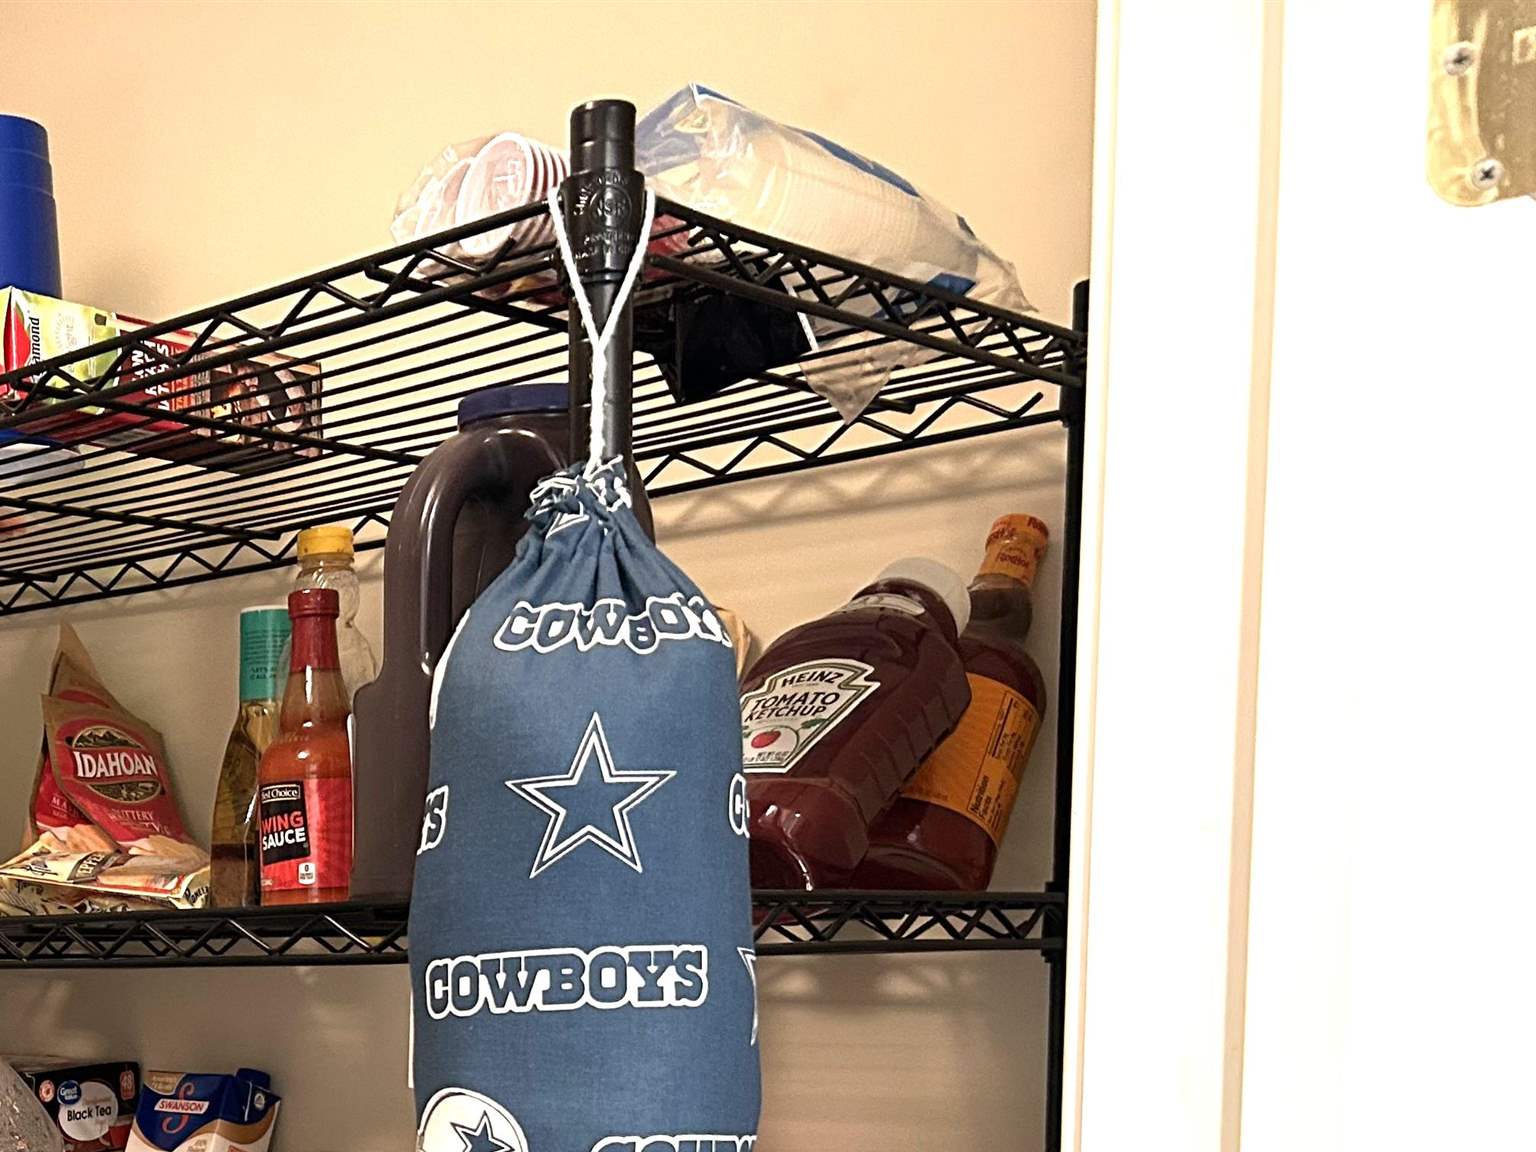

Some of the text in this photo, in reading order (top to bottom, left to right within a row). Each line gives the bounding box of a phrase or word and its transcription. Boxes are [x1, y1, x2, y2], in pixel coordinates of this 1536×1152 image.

[493, 591, 734, 655] COWBOY
[781, 669, 845, 688] HEINZ
[750, 689, 841, 711] TOMATO
[744, 703, 829, 723] KETCHUP
[73, 750, 158, 779] IDAHOAN
[271, 788, 298, 798] Choice
[262, 810, 304, 833] WING
[262, 827, 307, 850] SAUCE
[425, 944, 709, 1020] COWBOYS
[67, 1105, 112, 1122] Black Tea
[158, 1100, 204, 1111] SWANSON
